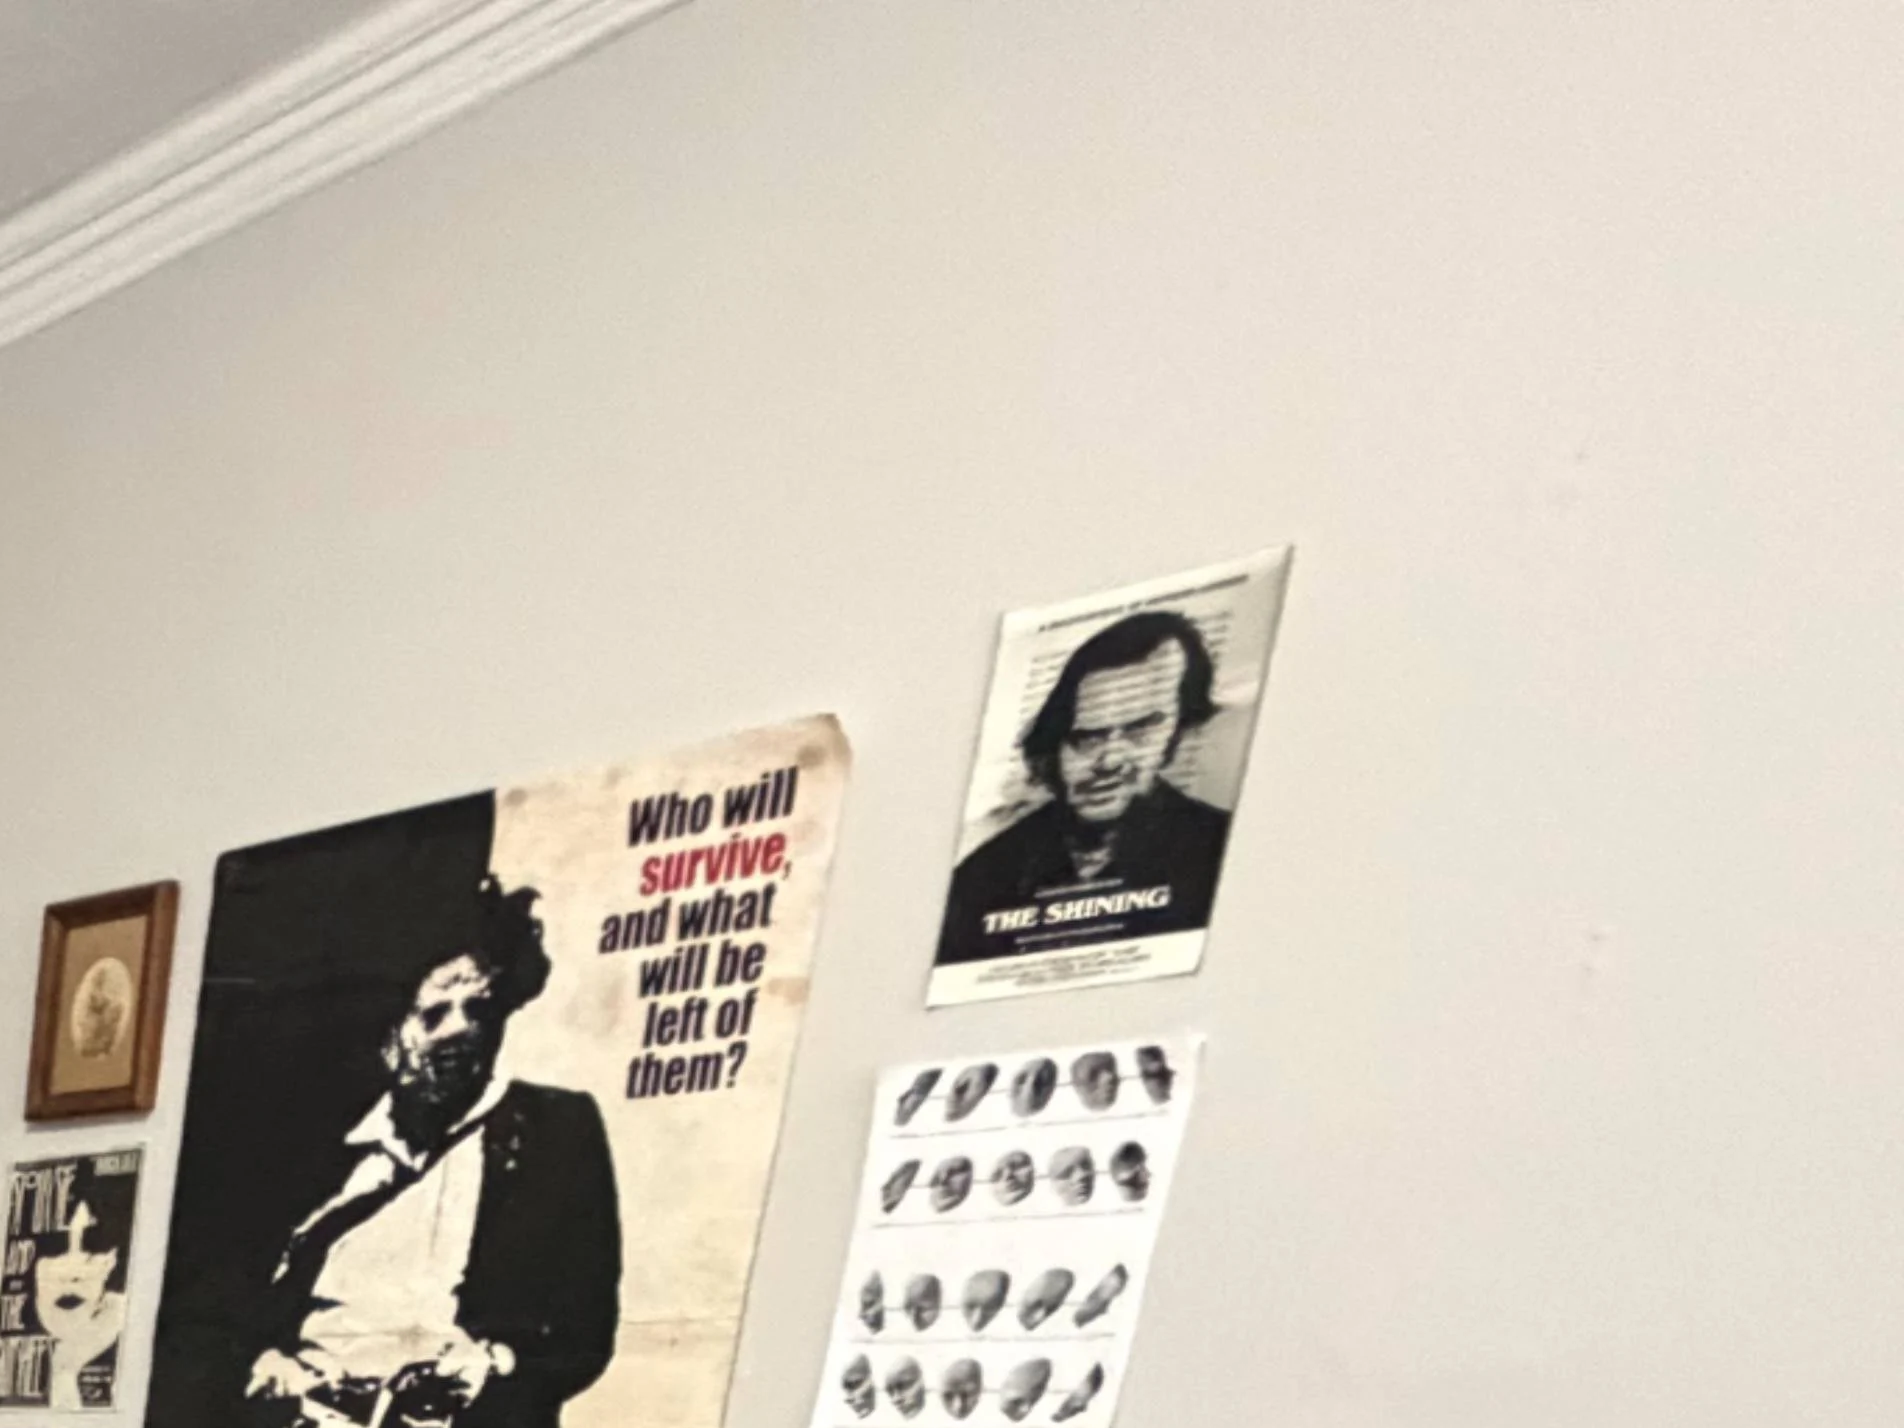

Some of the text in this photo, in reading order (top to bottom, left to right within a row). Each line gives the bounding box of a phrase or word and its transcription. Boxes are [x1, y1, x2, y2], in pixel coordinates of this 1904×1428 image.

[628, 766, 798, 847] Who will
[639, 832, 792, 897] survive,
[598, 882, 776, 954] and what
[983, 906, 1040, 934] THE
[1043, 885, 1171, 924] SHINING
[640, 940, 767, 999] will be
[642, 988, 759, 1049] left of
[626, 1041, 747, 1098] them?
